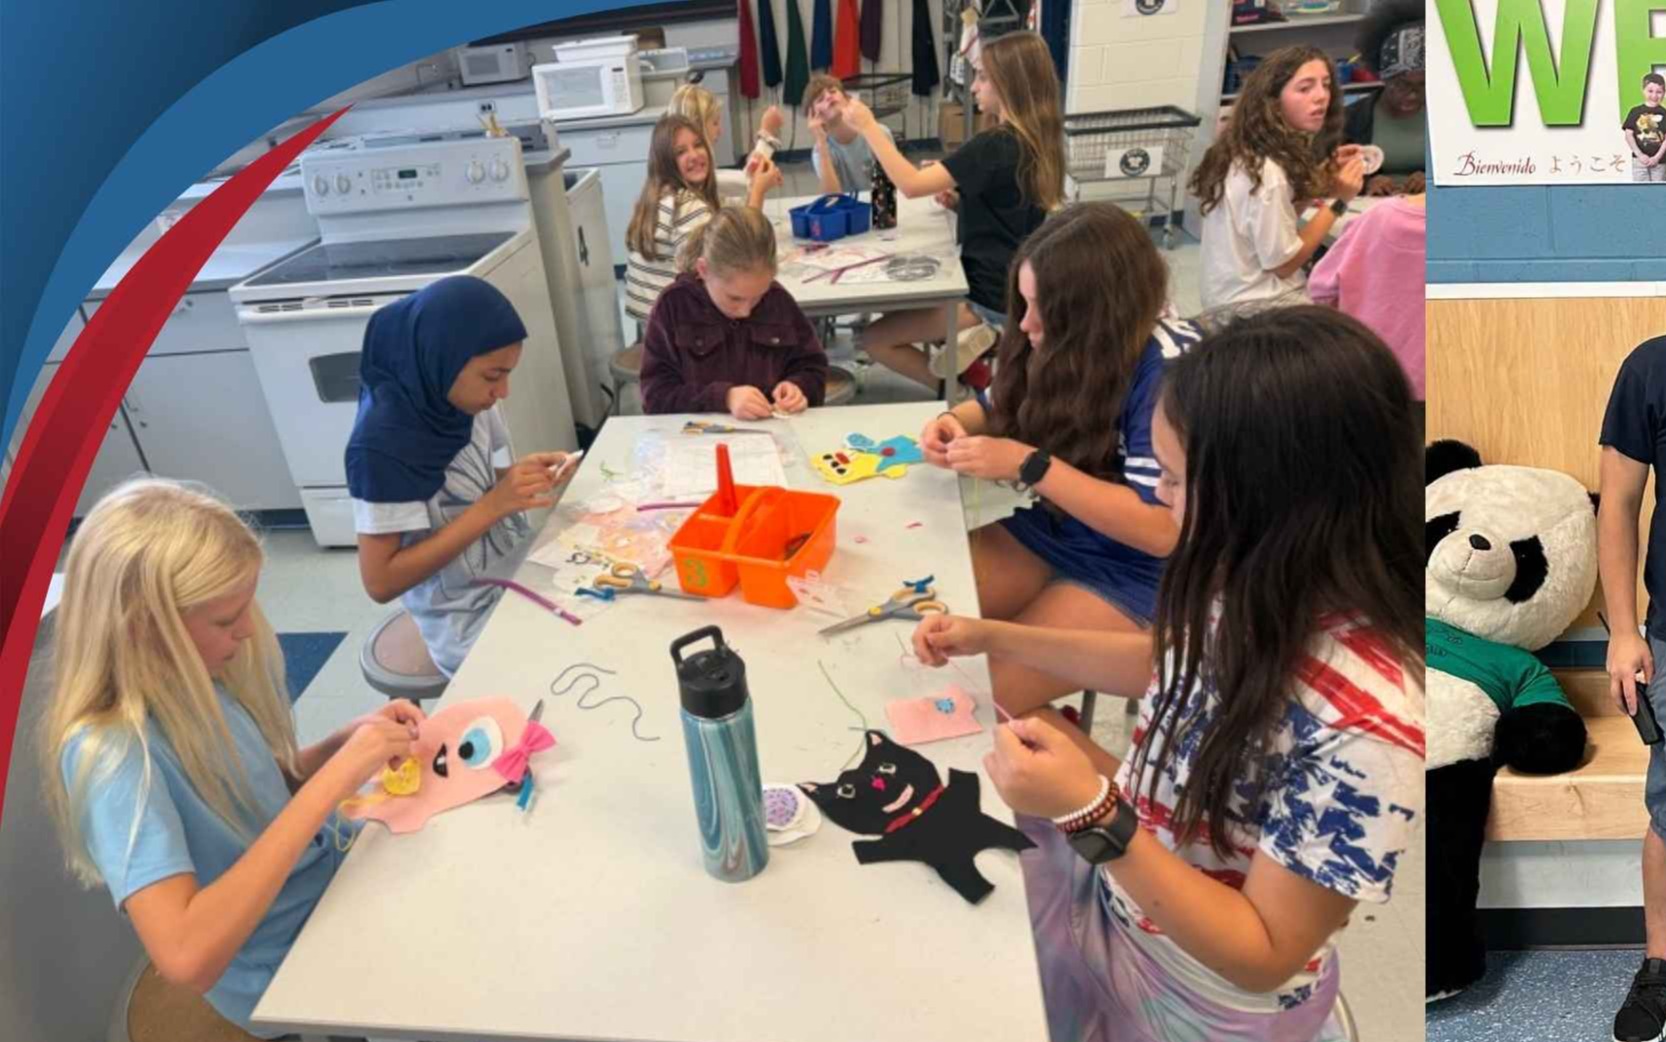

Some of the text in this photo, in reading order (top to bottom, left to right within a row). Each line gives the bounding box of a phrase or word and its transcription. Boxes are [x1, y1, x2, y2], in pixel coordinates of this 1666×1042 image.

[1454, 150, 1537, 175] Bienvenido
[1549, 154, 1625, 173] ようこそ
